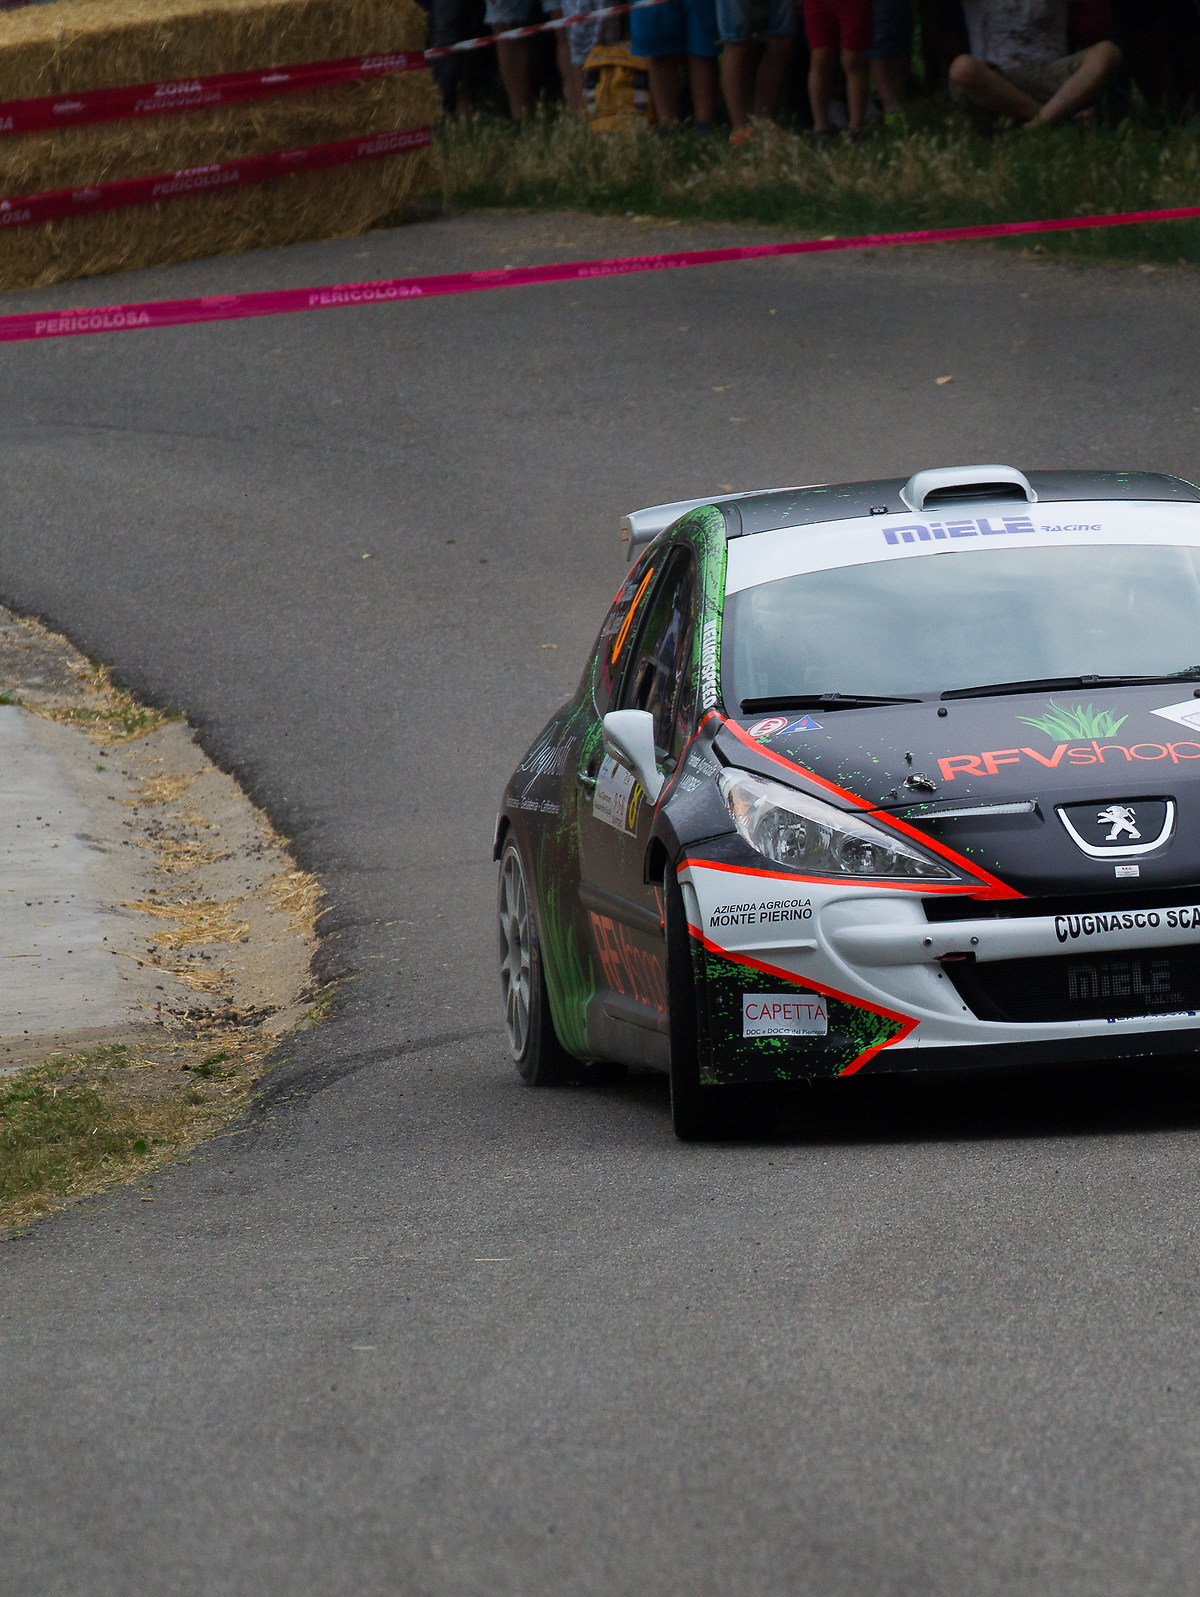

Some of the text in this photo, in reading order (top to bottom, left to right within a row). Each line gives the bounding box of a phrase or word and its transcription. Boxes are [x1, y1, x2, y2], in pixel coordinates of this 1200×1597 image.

[153, 79, 202, 97] ZONA
[308, 284, 422, 306] PERICOLOSA
[35, 310, 150, 334] PERICOLOSA
[713, 898, 812, 914] AZIENDA AGRICOLA
[709, 908, 813, 928] MONTE PIERINO
[1054, 912, 1161, 943] CUGNASCO
[745, 1003, 826, 1021] CAPETTA
